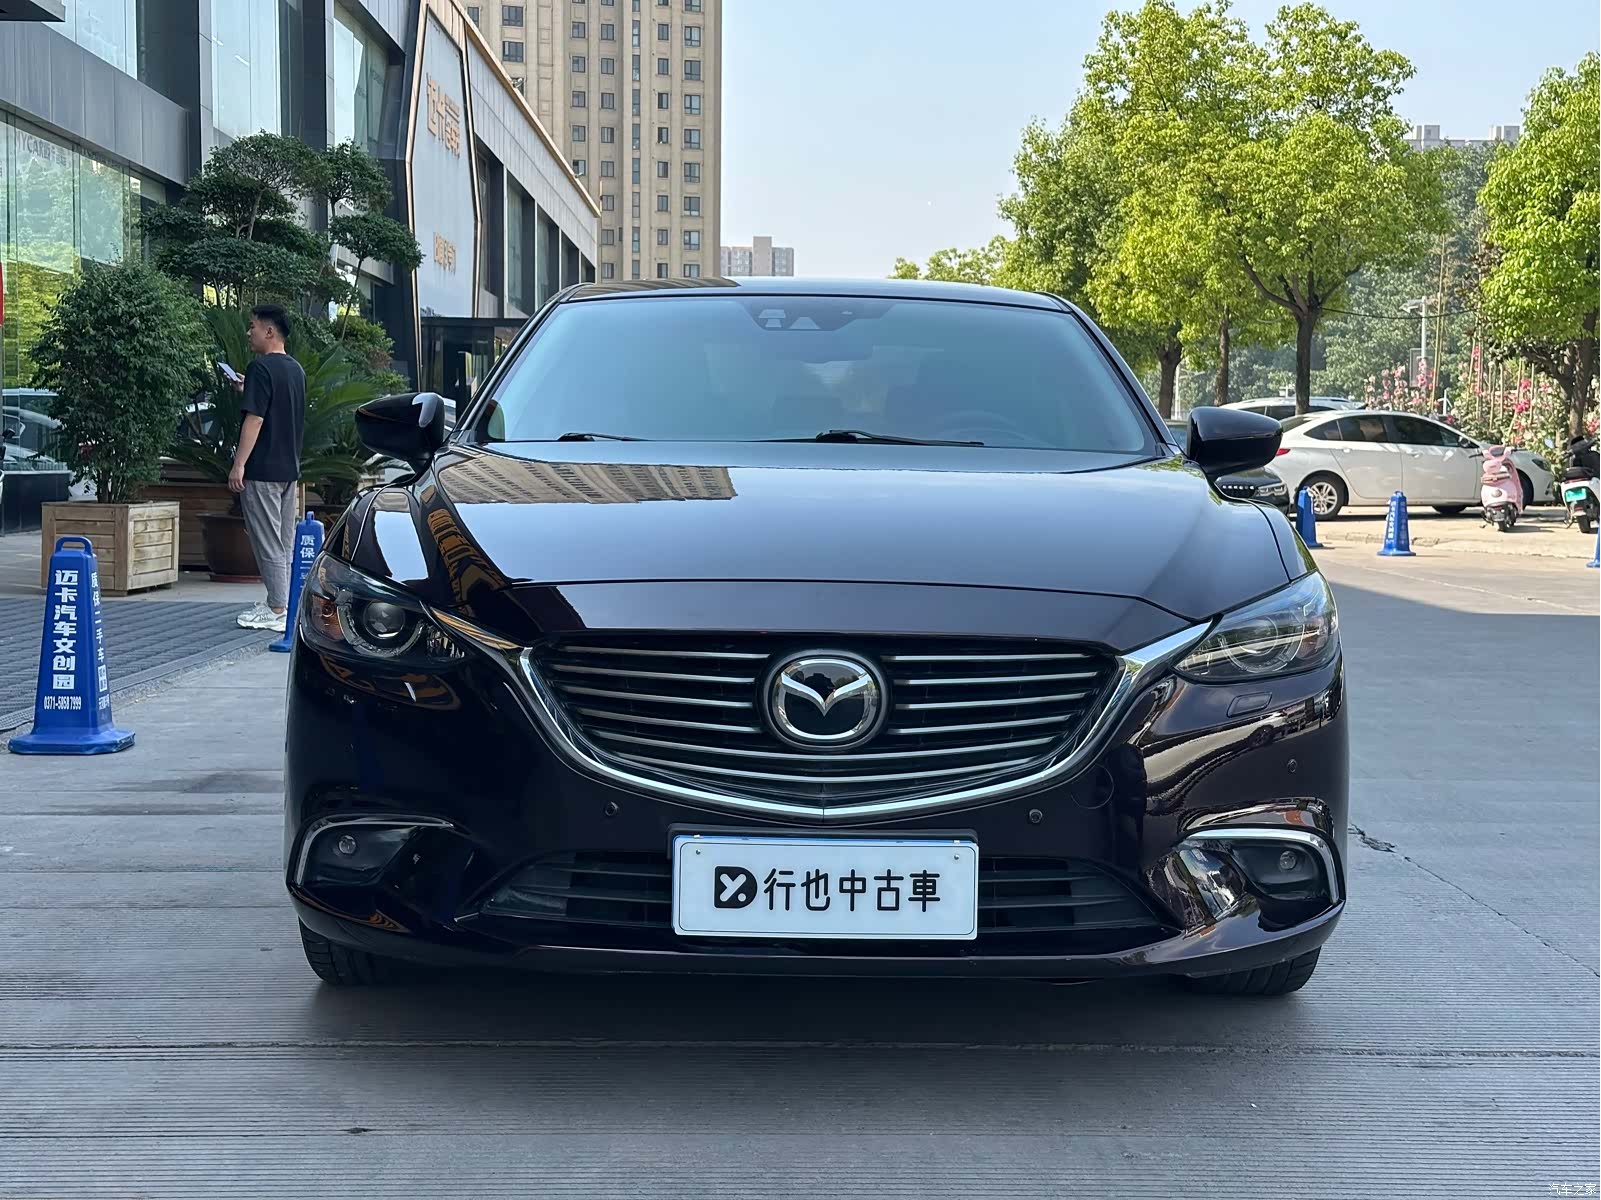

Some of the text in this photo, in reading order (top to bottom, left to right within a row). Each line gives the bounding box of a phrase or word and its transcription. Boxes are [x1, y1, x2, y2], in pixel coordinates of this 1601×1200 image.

[52, 569, 79, 690] 迈卡汽车文创园
[763, 867, 941, 913] 行也中古車
